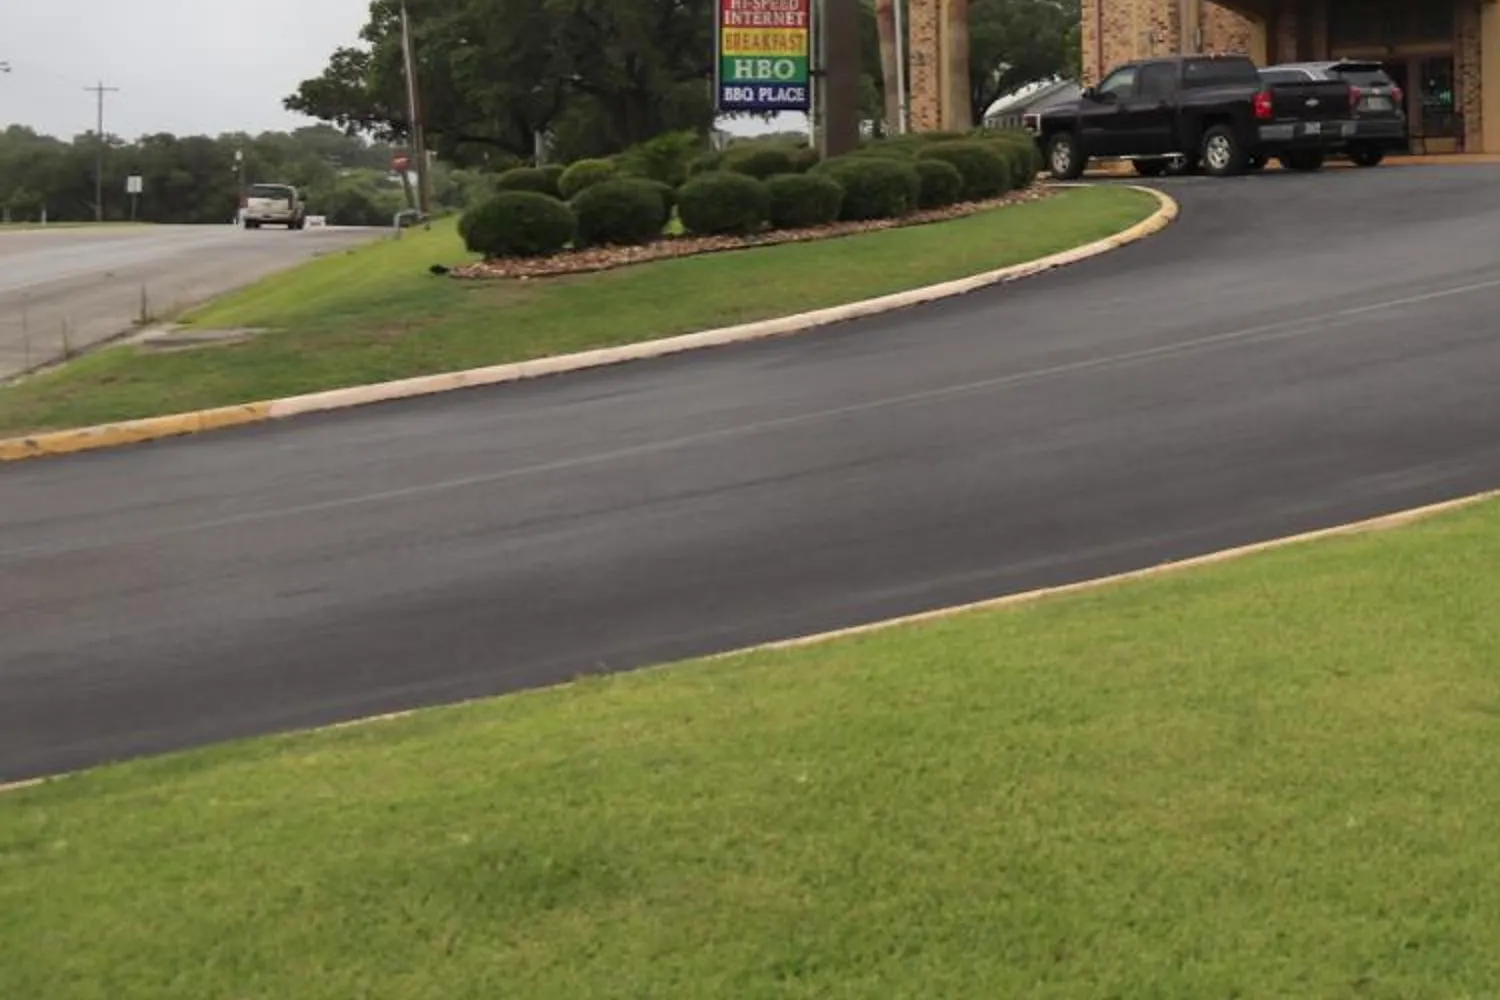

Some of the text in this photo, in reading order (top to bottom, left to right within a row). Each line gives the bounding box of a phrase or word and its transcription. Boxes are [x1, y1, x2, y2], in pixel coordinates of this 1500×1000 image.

[724, 11, 806, 26] INTERNET
[725, 33, 805, 50] BREAKFAST
[734, 60, 796, 79] HBO
[724, 87, 805, 102] BBQ PLACE
